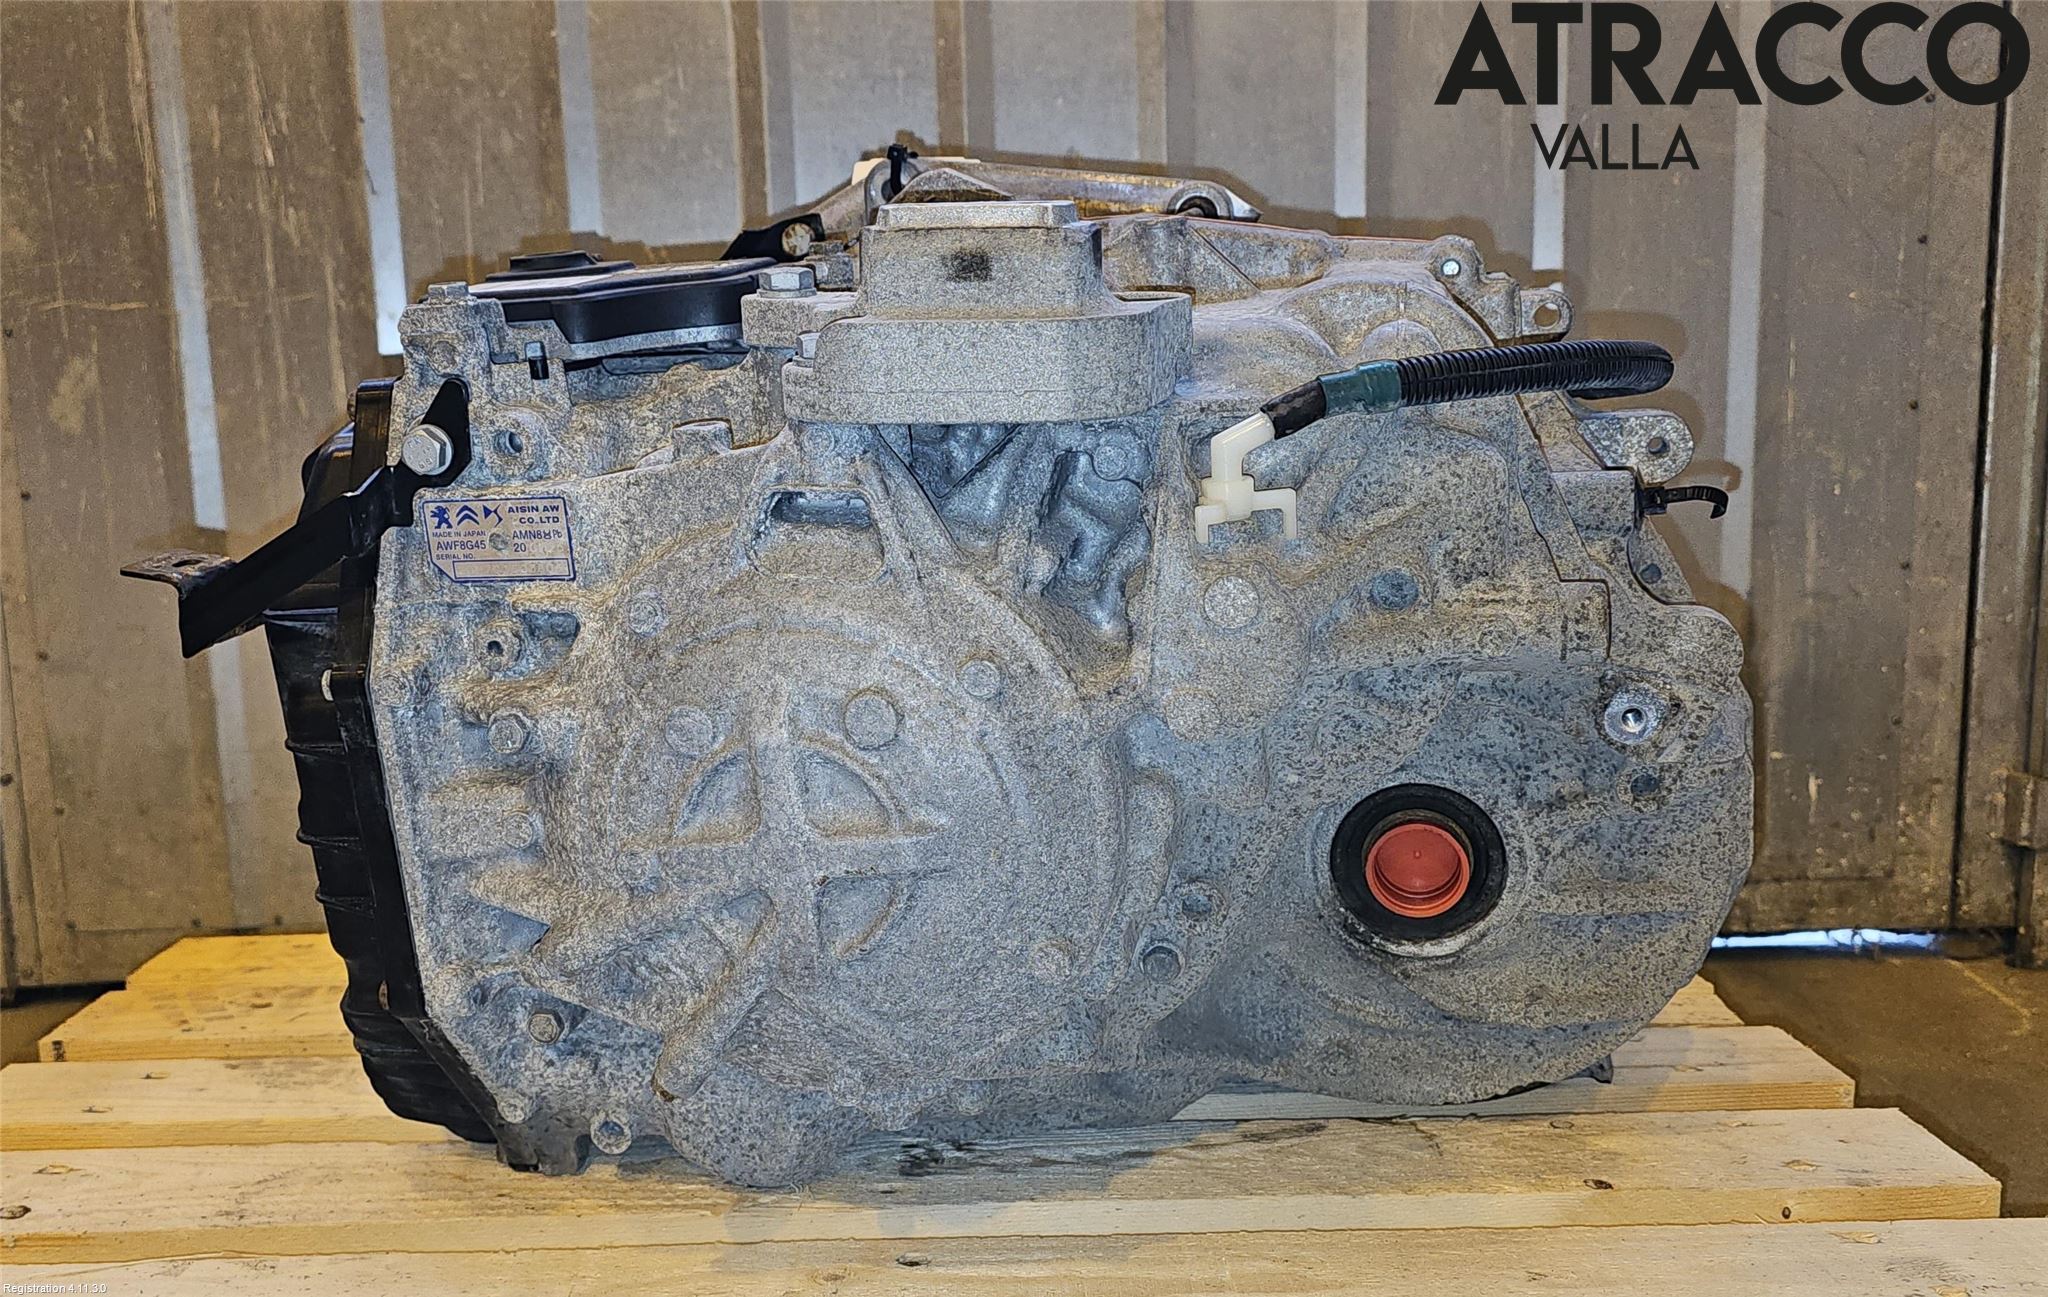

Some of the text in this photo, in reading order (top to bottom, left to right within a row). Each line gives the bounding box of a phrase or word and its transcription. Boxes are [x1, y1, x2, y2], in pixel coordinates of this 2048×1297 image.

[508, 504, 560, 513] AISIN AW
[437, 540, 487, 551] AWF8G45
[513, 542, 527, 553] 20
[436, 553, 462, 561] SERIAL
